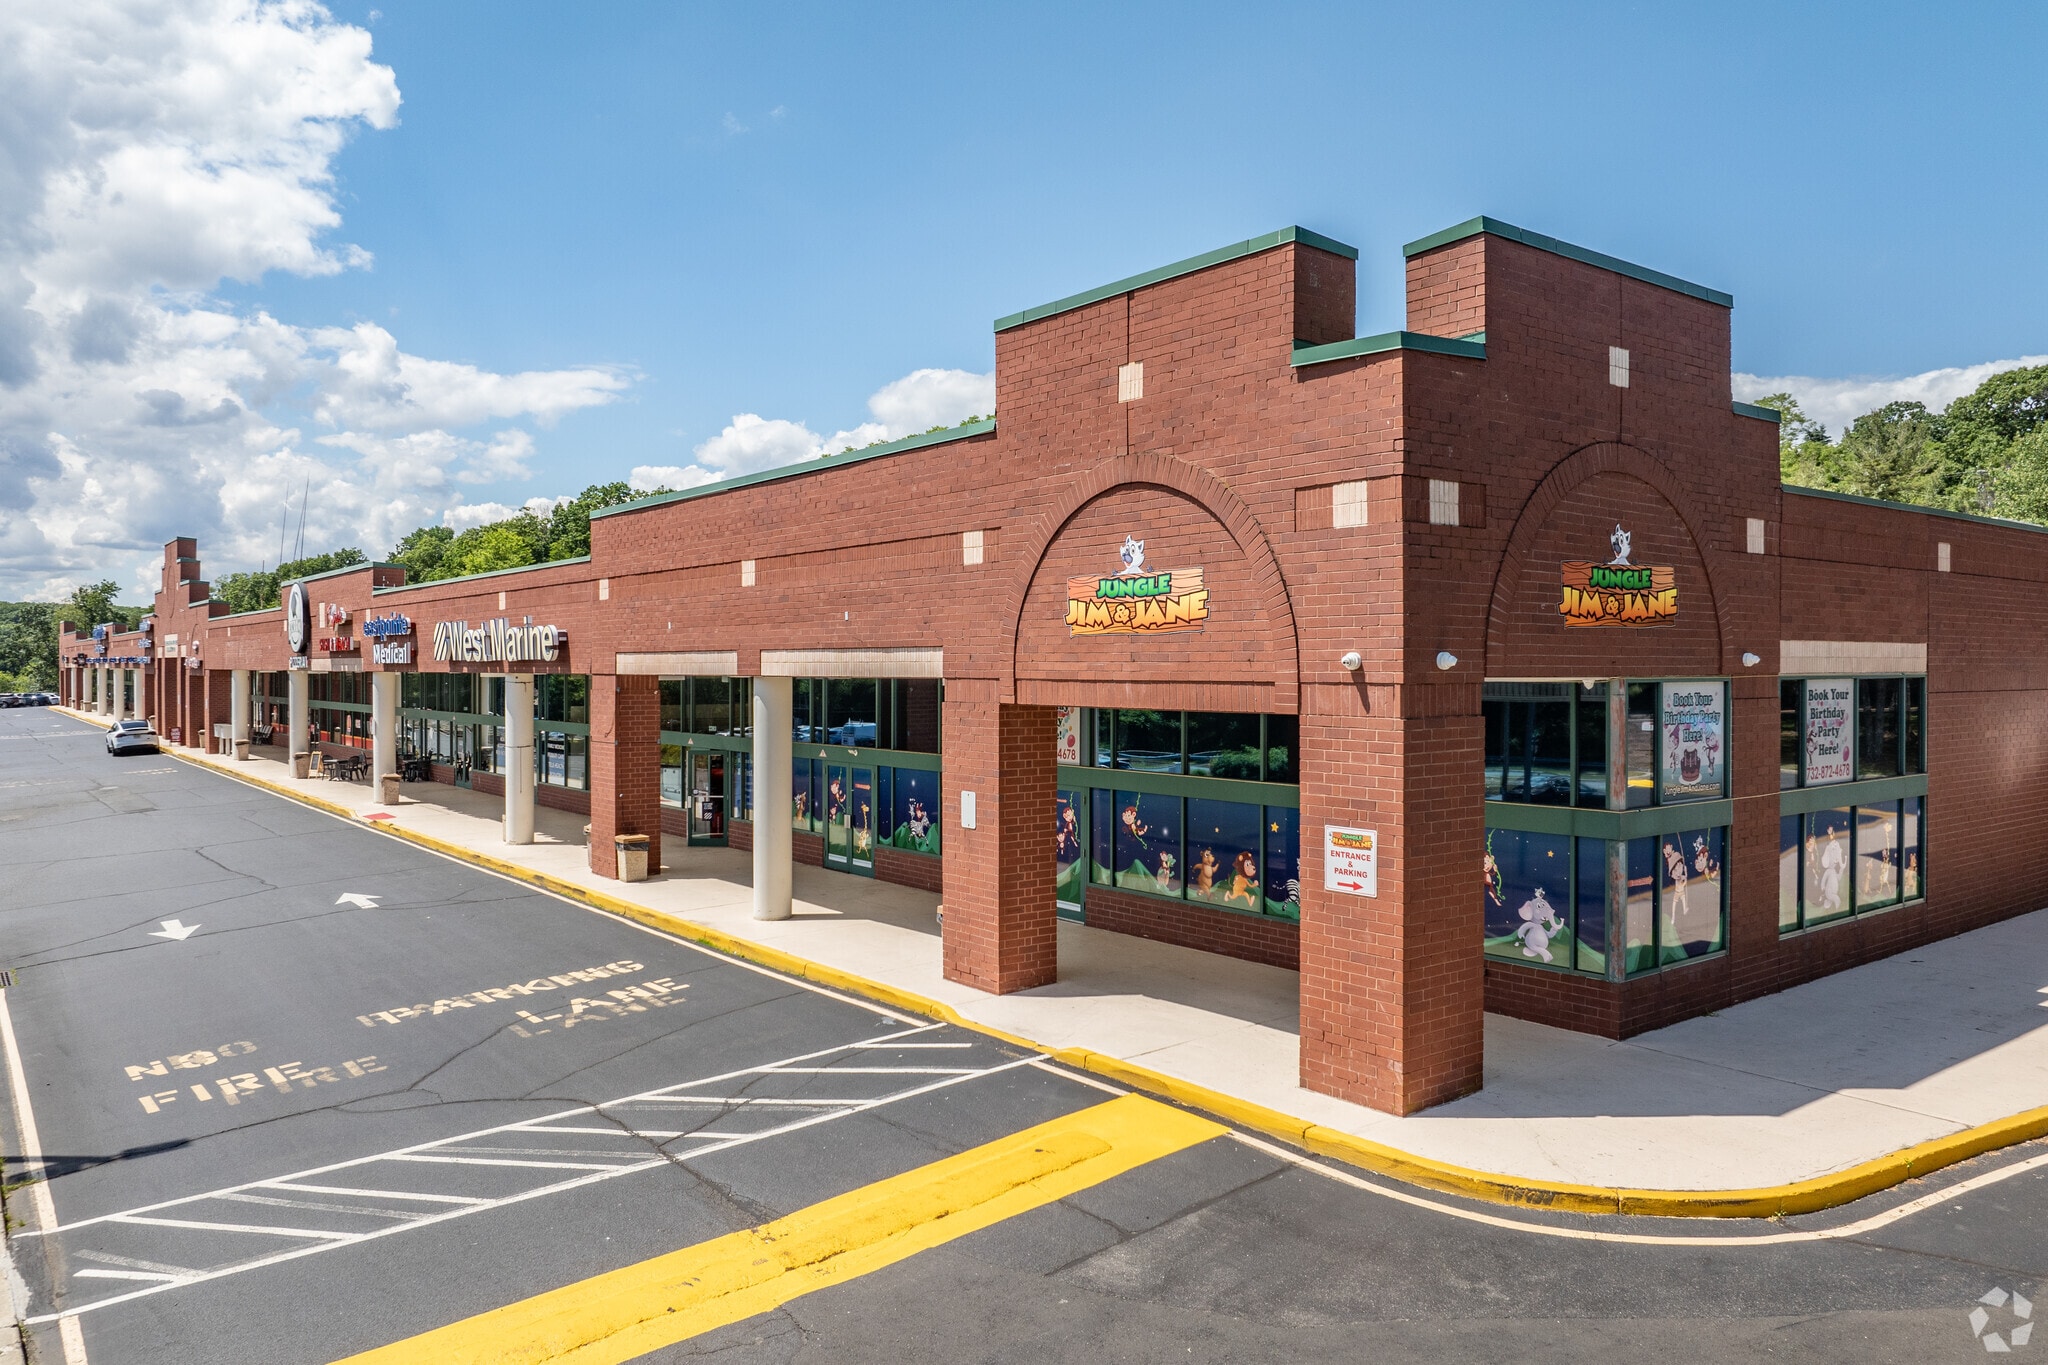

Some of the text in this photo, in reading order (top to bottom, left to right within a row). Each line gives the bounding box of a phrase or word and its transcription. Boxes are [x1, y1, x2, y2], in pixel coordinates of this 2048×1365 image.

[1589, 566, 1652, 590] JUNGLE
[1096, 573, 1172, 599] JUNGLE
[1065, 589, 1209, 629] JIM & JANE
[1559, 585, 1678, 623] JIM & JANE
[363, 611, 411, 641] eastpointe
[448, 616, 557, 662] West Marine
[373, 642, 411, 664] Medical
[1673, 692, 1713, 706] Book Your
[1808, 688, 1849, 701] Book Your
[1664, 710, 1721, 727] Birthday Party
[1810, 707, 1845, 720] Birthday
[1683, 728, 1703, 742] Here!
[1817, 726, 1840, 738] Party
[1818, 743, 1839, 756] Here!
[1807, 763, 1850, 780] 732-872-4678
[1341, 833, 1363, 841] JUNGLE
[1330, 850, 1371, 861] ENTRANCE
[1334, 867, 1368, 878] PARKING
